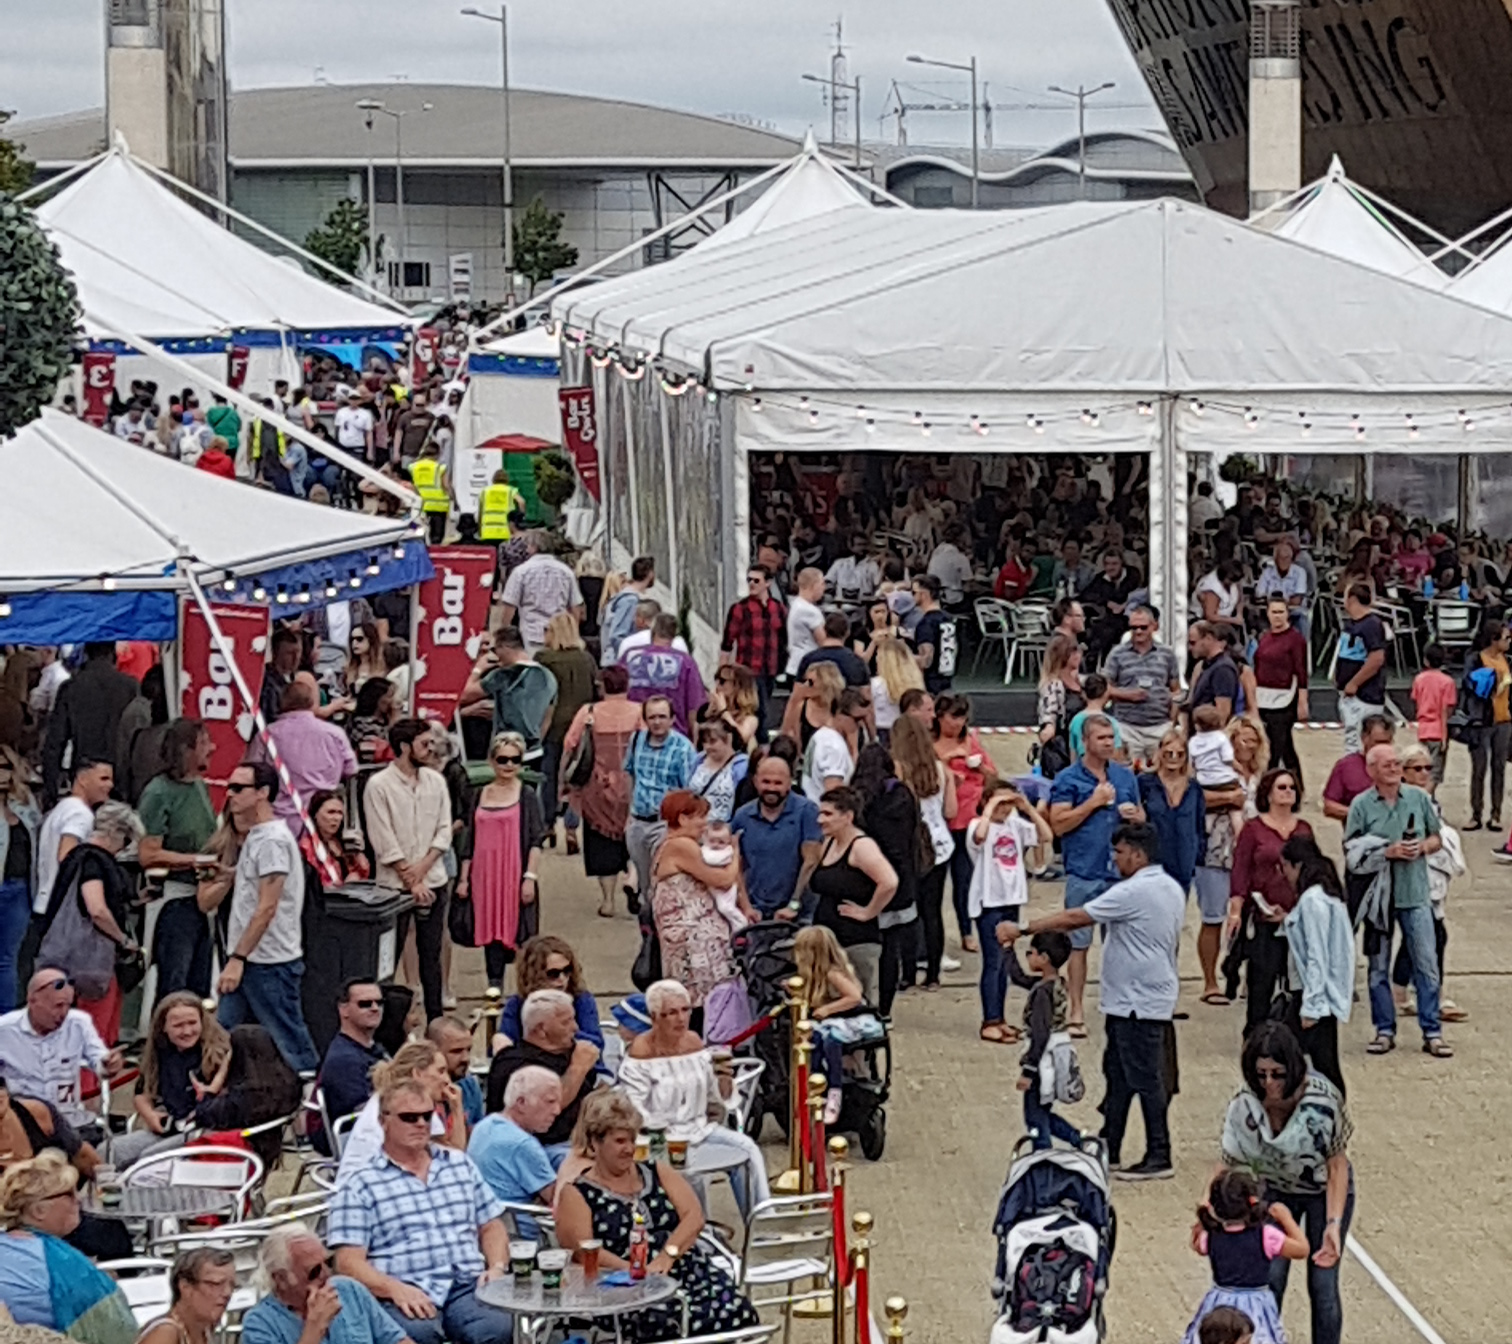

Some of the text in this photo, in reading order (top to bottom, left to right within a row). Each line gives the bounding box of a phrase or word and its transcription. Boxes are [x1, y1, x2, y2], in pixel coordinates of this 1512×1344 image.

[415, 338, 433, 362] G
[231, 358, 243, 378] F
[433, 567, 465, 645] Bar
